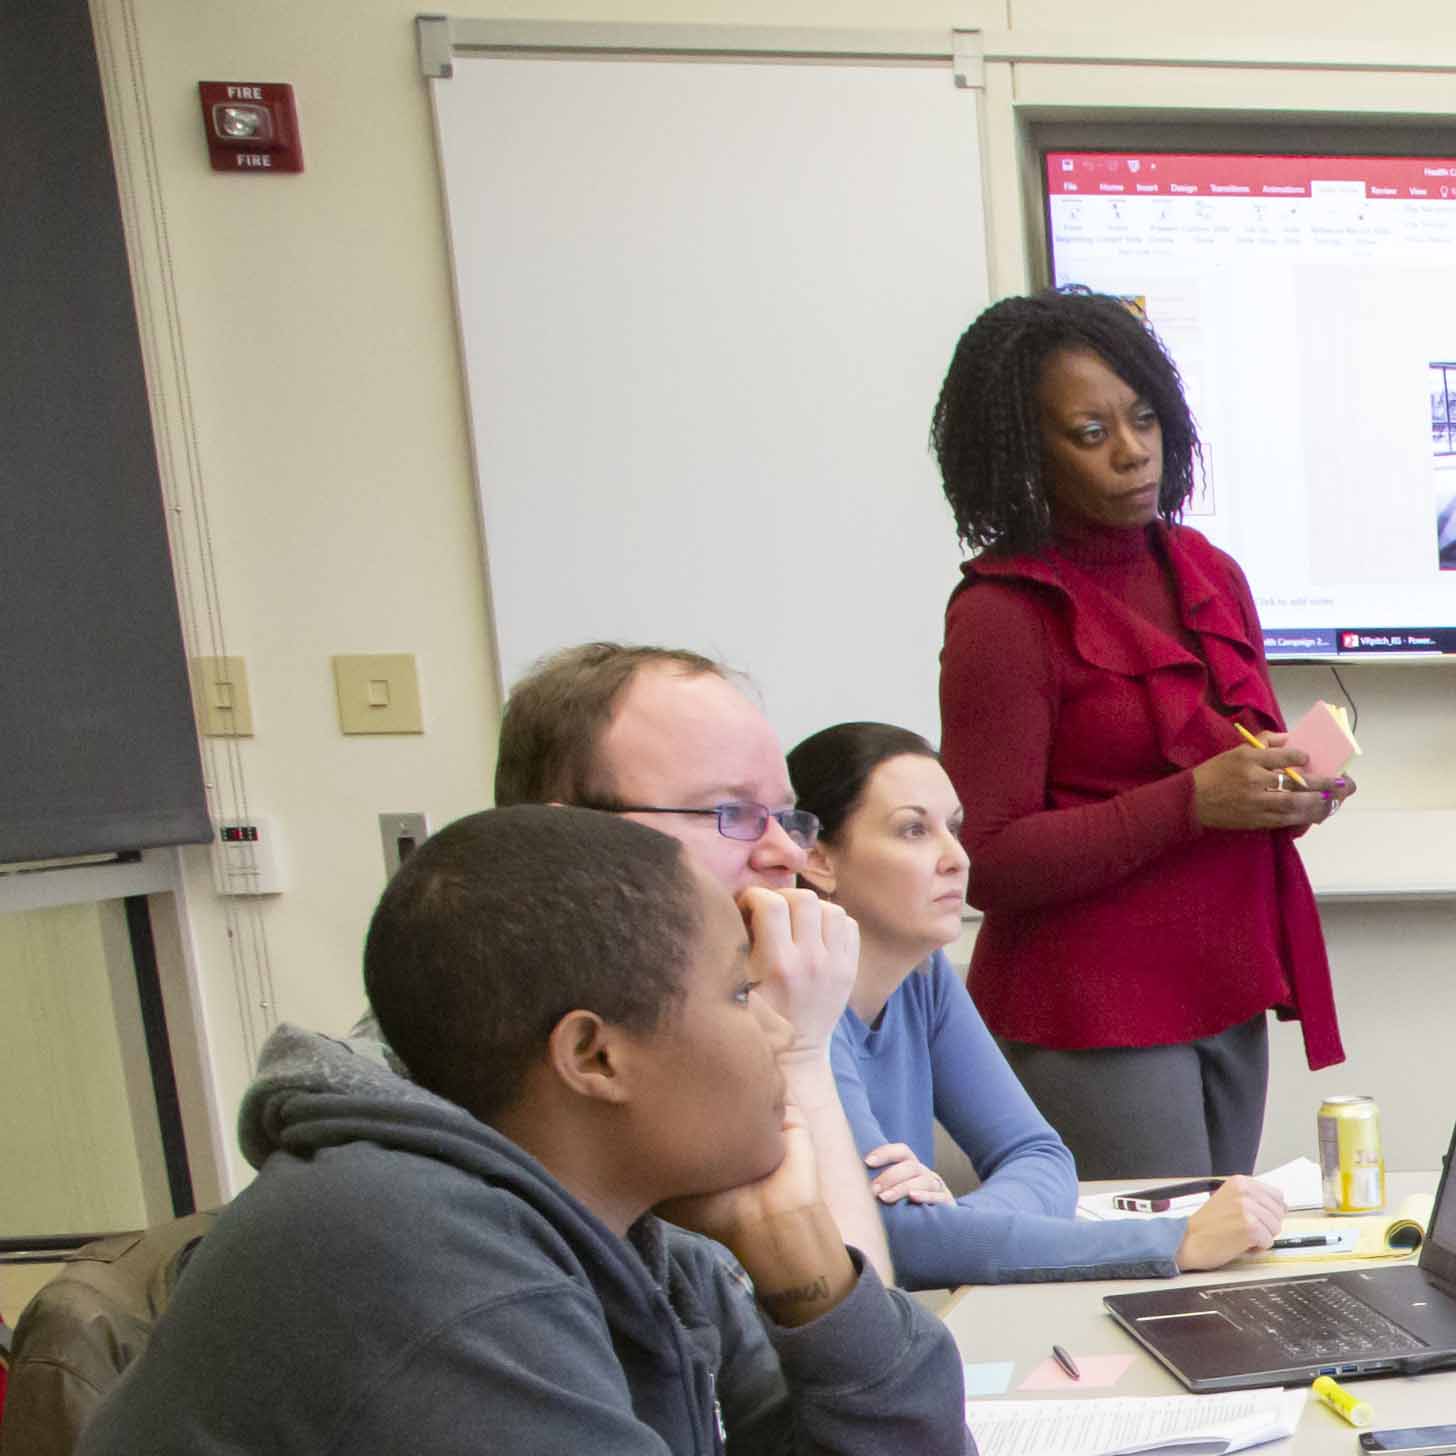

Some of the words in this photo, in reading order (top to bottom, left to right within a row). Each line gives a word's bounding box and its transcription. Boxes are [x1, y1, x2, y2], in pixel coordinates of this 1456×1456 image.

[226, 86, 263, 100] FIRE
[236, 154, 272, 167] FIRE
[1063, 182, 1078, 192] File
[1099, 183, 1125, 192] Home
[1136, 183, 1159, 192] Insert
[1170, 183, 1198, 194] Design
[1209, 184, 1250, 193] Transitions
[1262, 185, 1305, 194] Animations
[1371, 186, 1397, 195] Review
[1408, 187, 1428, 196] View
